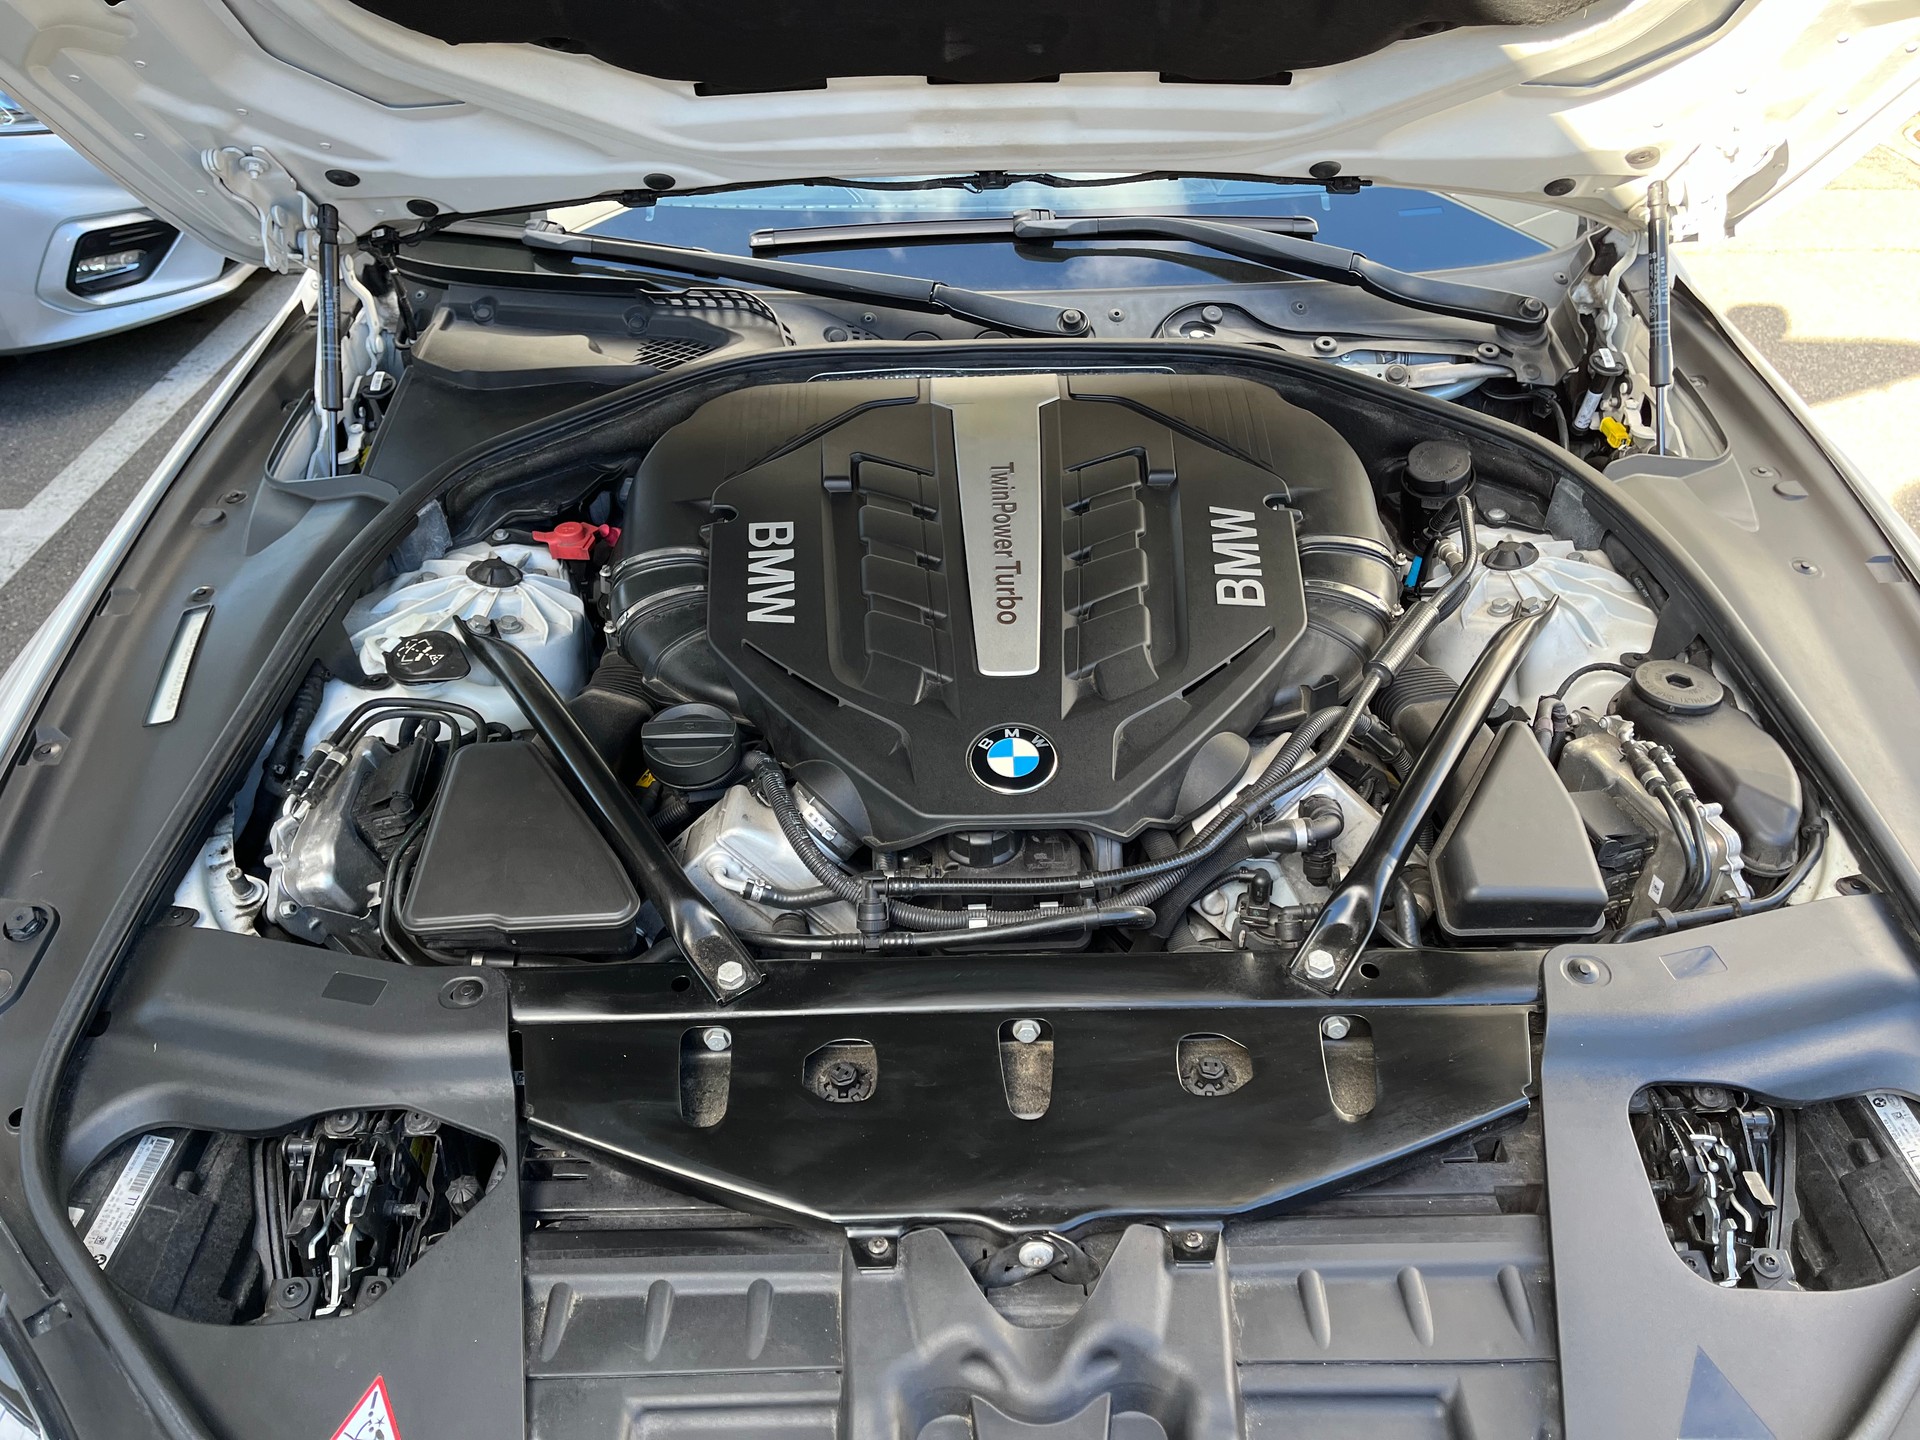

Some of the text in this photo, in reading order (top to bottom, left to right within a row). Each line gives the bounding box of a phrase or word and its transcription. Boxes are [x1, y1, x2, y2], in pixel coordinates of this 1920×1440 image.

[747, 521, 796, 624] BMW
[1209, 506, 1266, 606] BMW
[977, 728, 1050, 751] BMW
